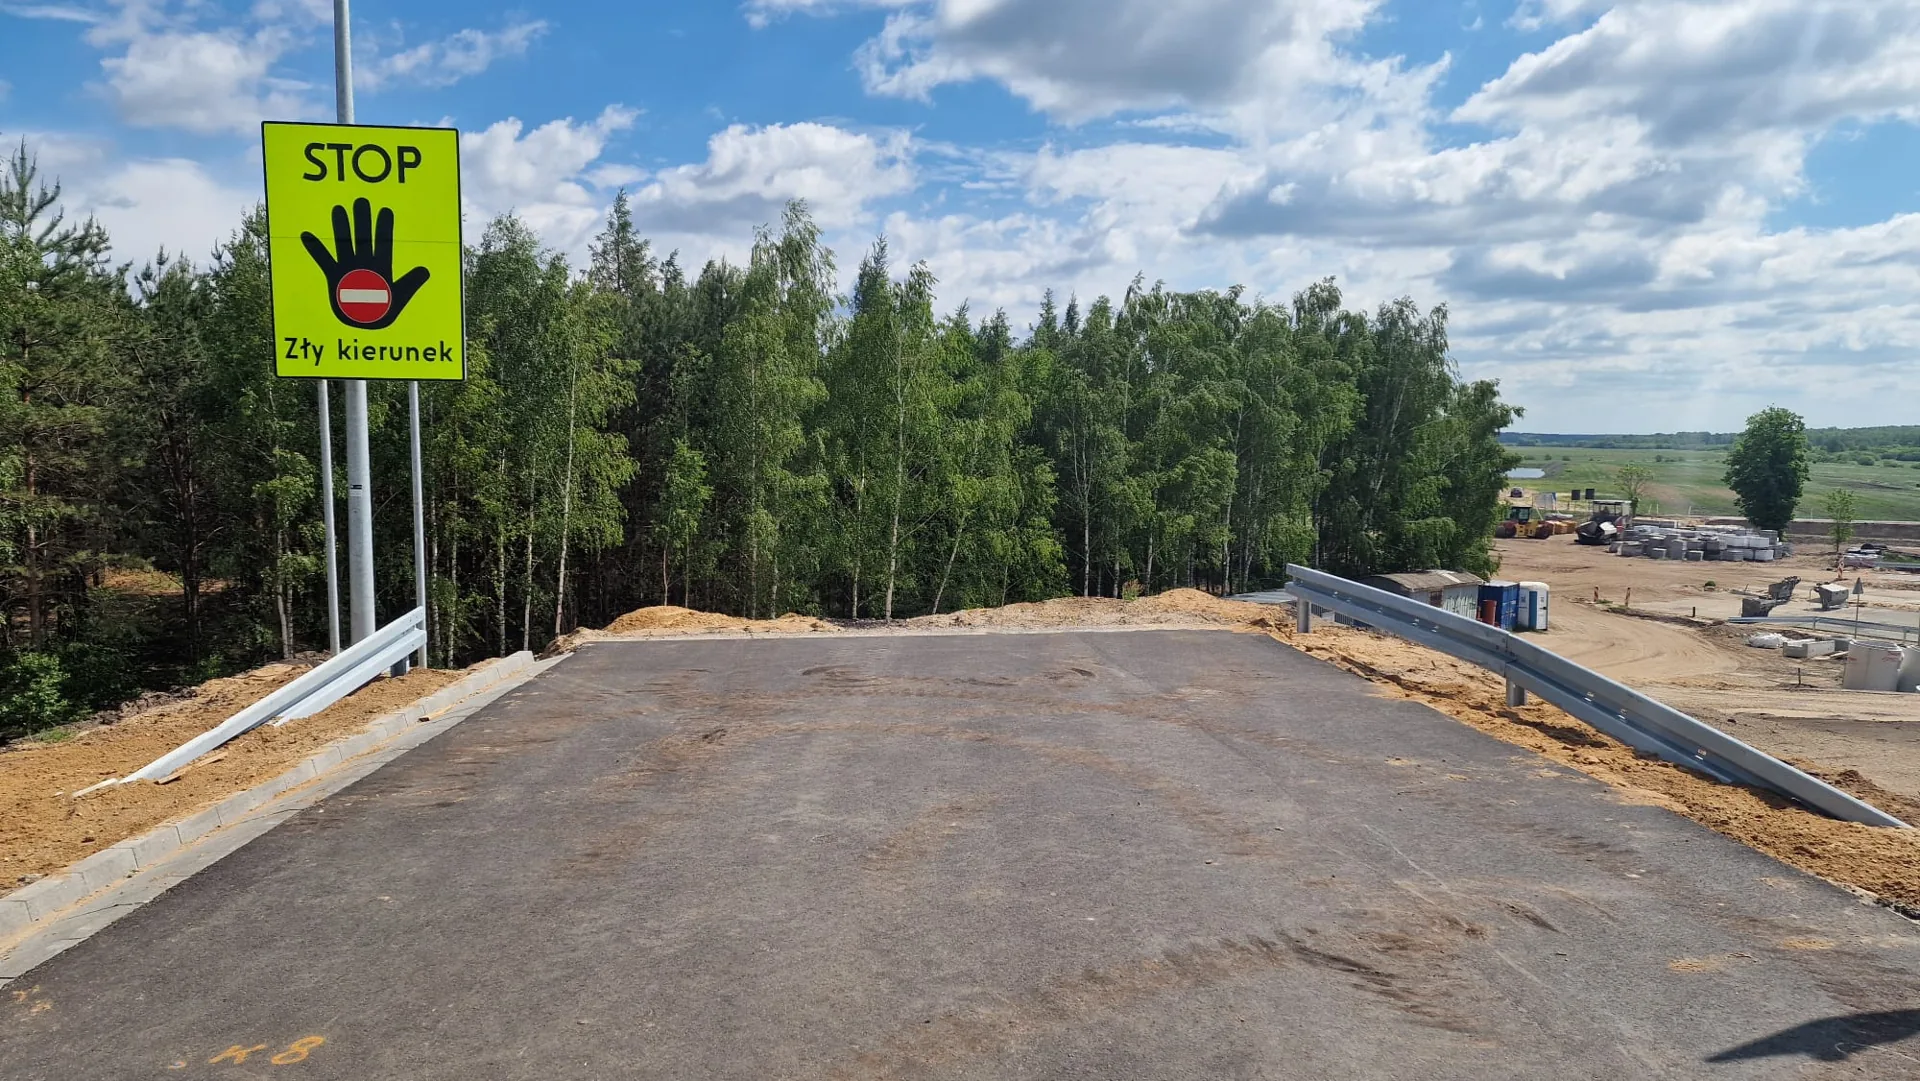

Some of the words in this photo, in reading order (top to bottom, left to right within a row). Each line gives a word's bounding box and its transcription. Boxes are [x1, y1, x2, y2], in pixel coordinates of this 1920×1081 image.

[302, 142, 422, 184] STOP
[284, 337, 324, 367] Zły
[337, 338, 453, 362] kierunek
